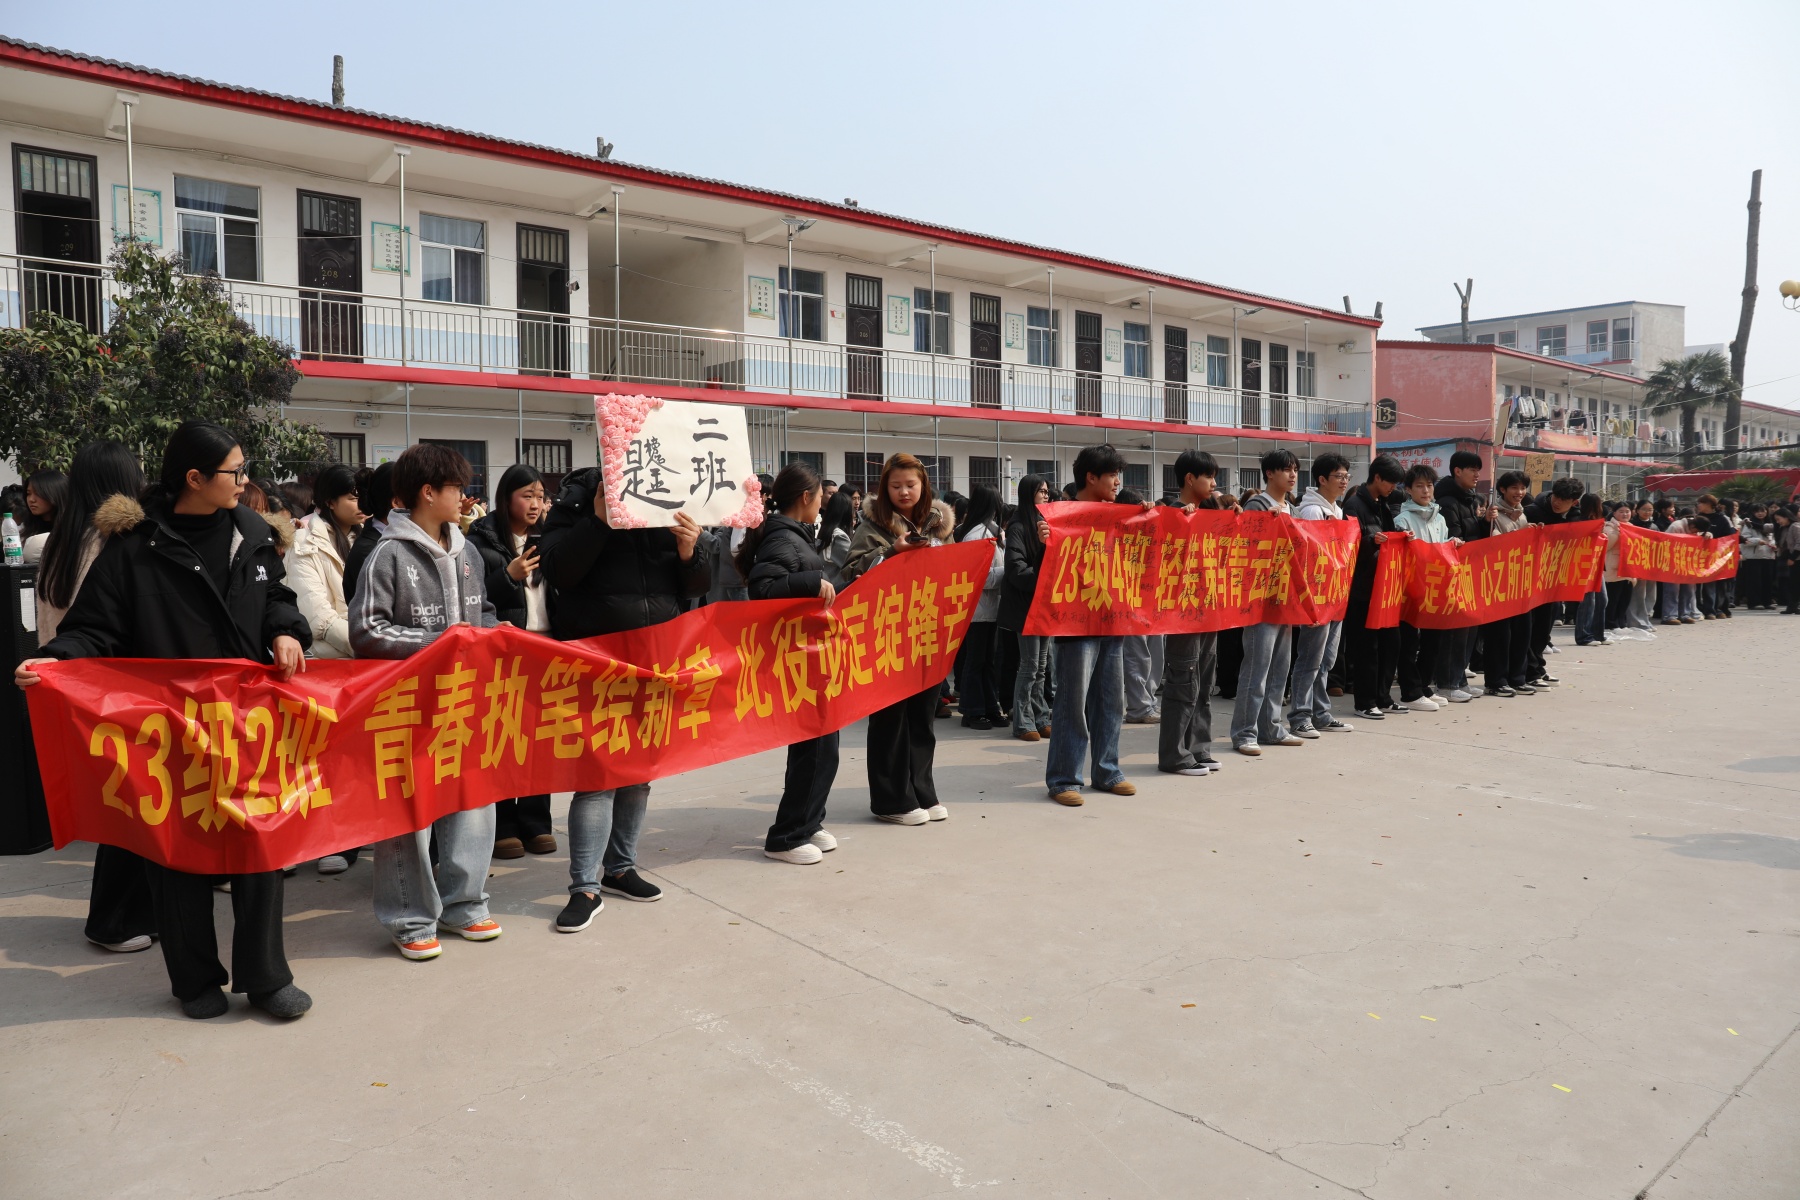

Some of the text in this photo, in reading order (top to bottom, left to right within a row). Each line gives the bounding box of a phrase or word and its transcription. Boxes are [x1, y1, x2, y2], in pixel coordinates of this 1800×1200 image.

[321, 269, 339, 279] 208
[690, 418, 737, 508] 二班
[1051, 527, 1150, 612] 23级4班
[1480, 545, 1534, 607] 心之所向
[90, 571, 974, 833] 23级2班 青春执笔绘新章 此役必定绽锋芒
